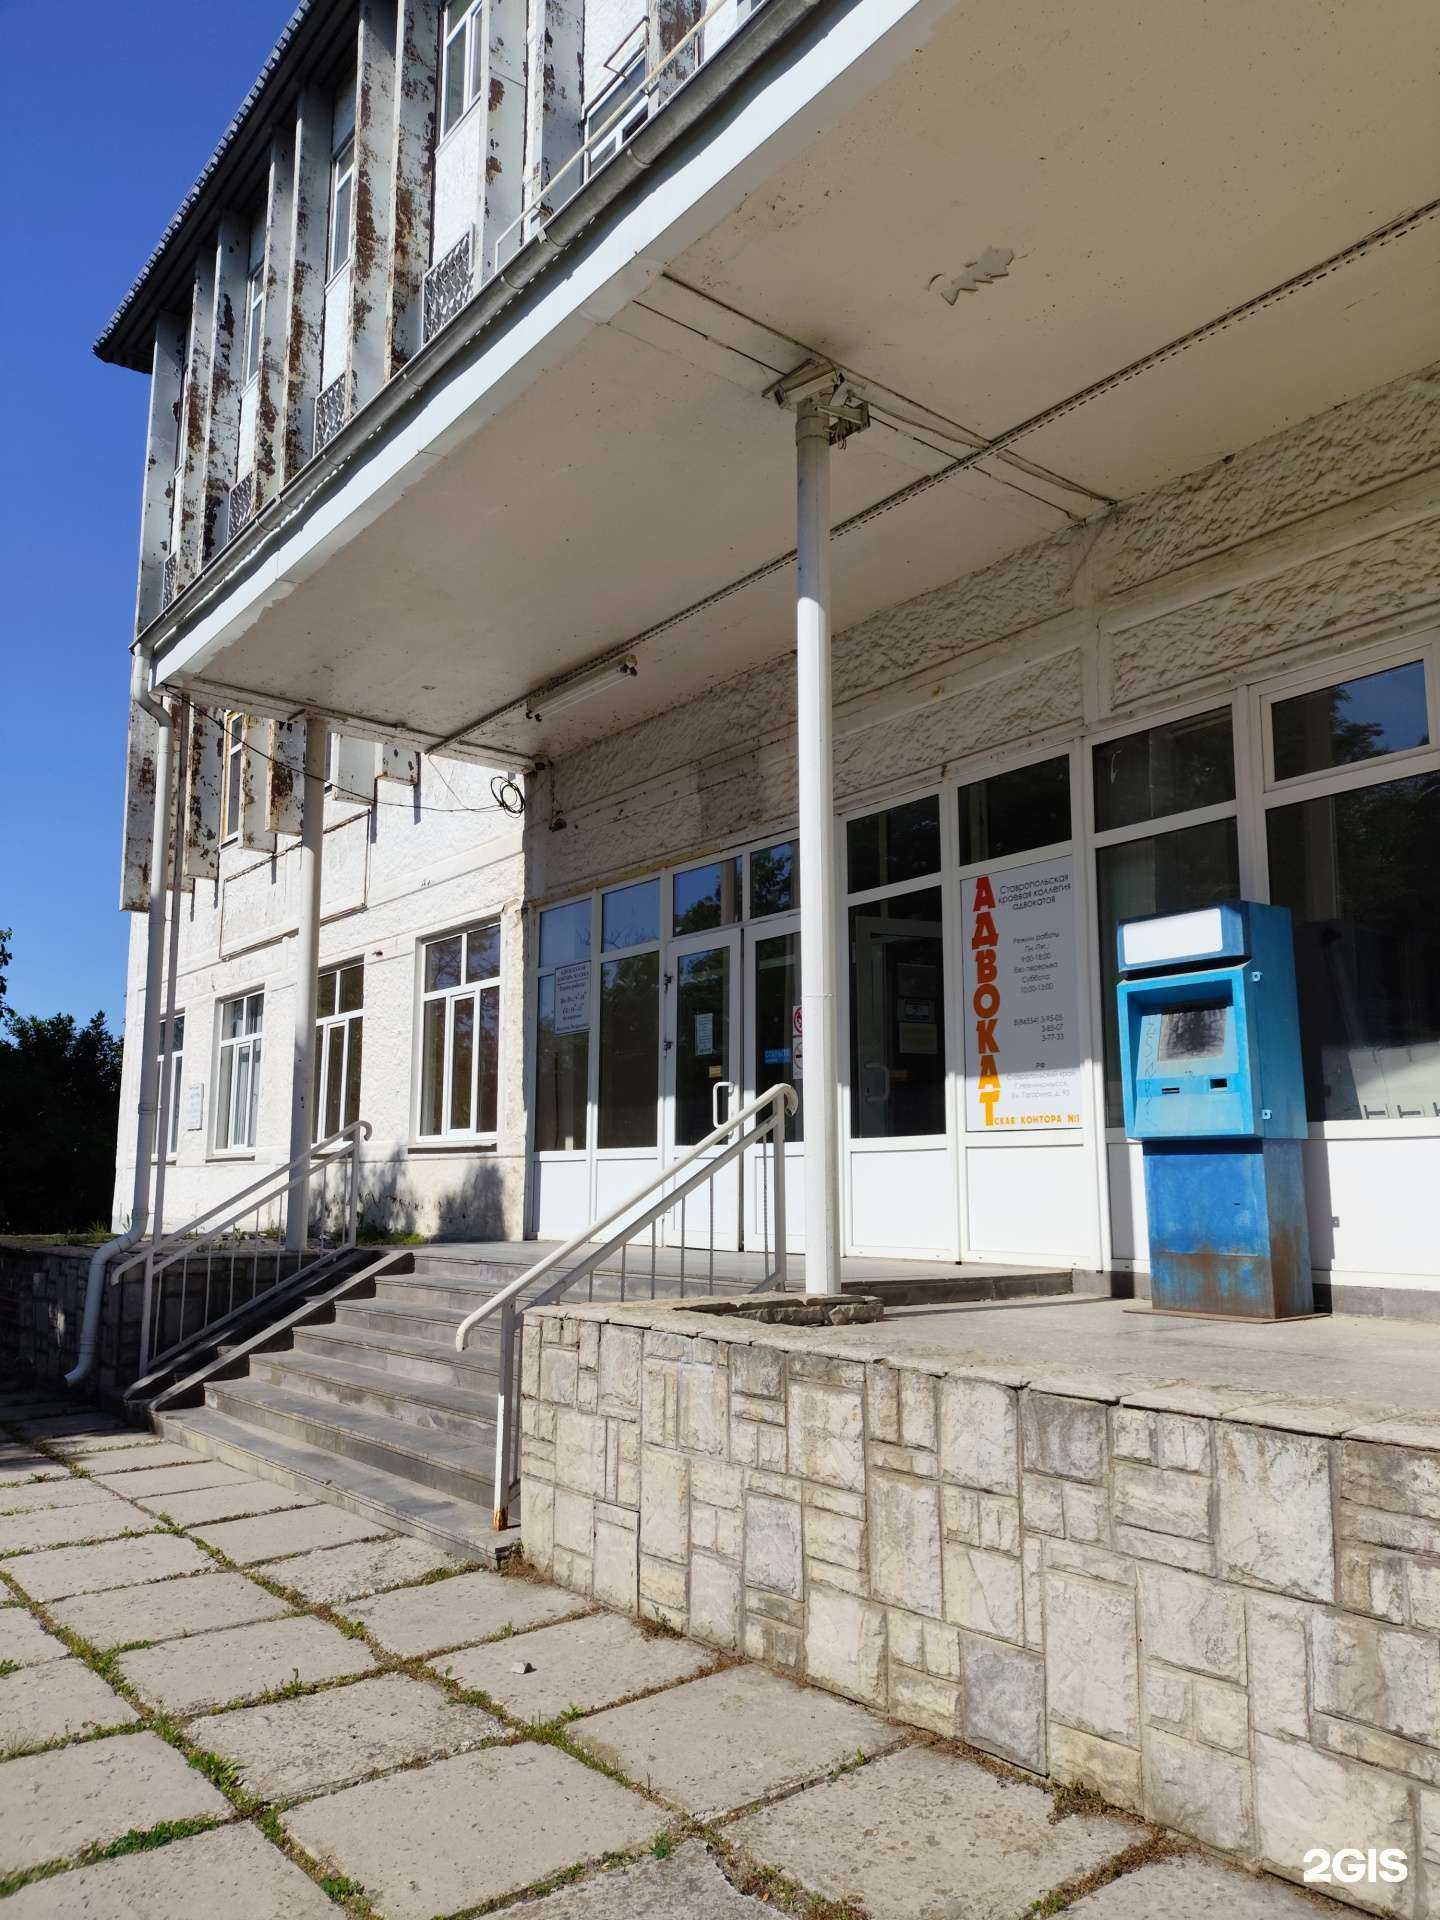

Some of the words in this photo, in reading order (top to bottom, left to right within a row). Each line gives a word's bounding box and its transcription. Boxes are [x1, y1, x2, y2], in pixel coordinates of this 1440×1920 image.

[999, 889, 1031, 903] краевая
[1034, 883, 1071, 897] коллегия
[1000, 874, 1069, 894] Ставропольская
[1013, 896, 1056, 910] адвокатов
[972, 876, 1001, 1126] АДВОКАТ
[1020, 1113, 1062, 1125] КОНТОРА
